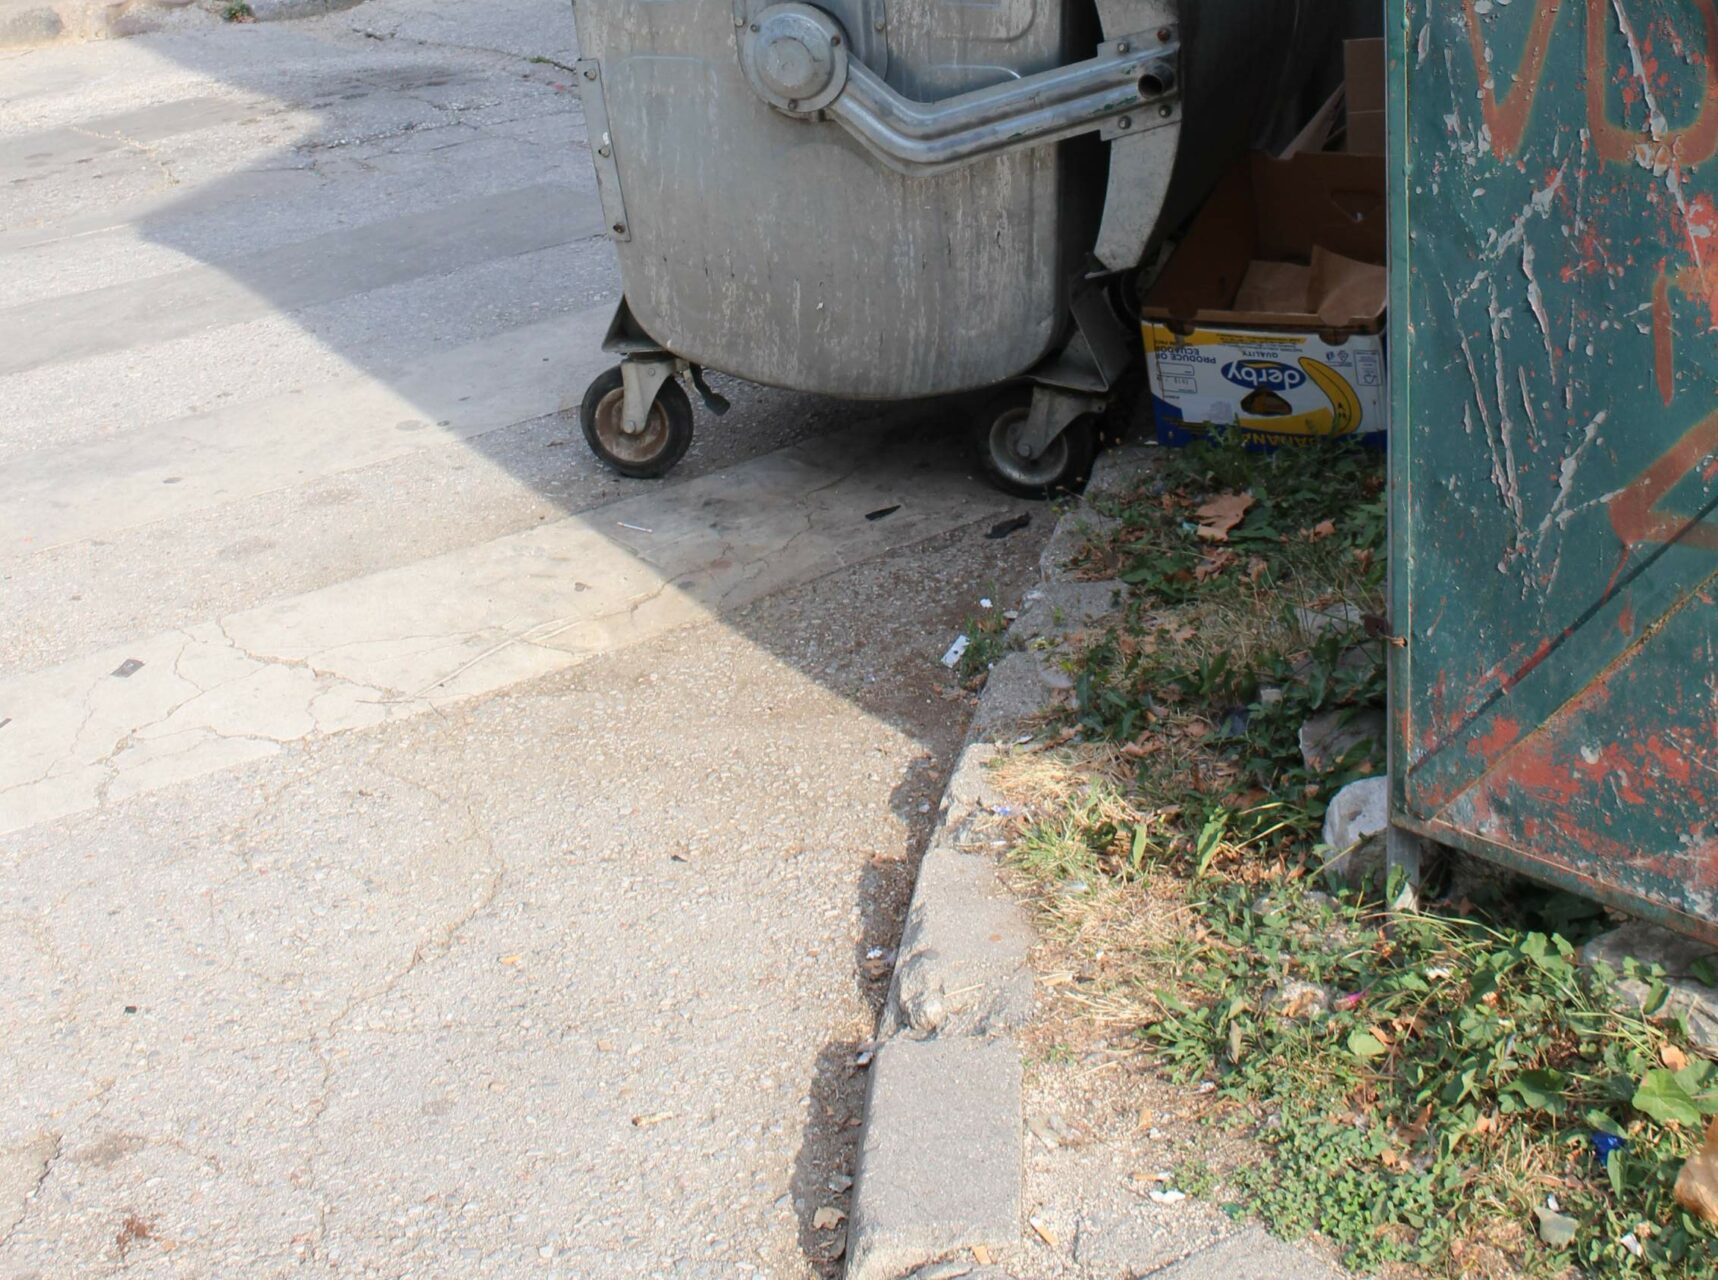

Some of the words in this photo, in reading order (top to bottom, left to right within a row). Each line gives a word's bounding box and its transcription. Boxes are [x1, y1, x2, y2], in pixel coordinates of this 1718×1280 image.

[1170, 352, 1217, 365] PRODUCE
[1242, 350, 1279, 359] QUALITY
[1228, 361, 1301, 391] derby
